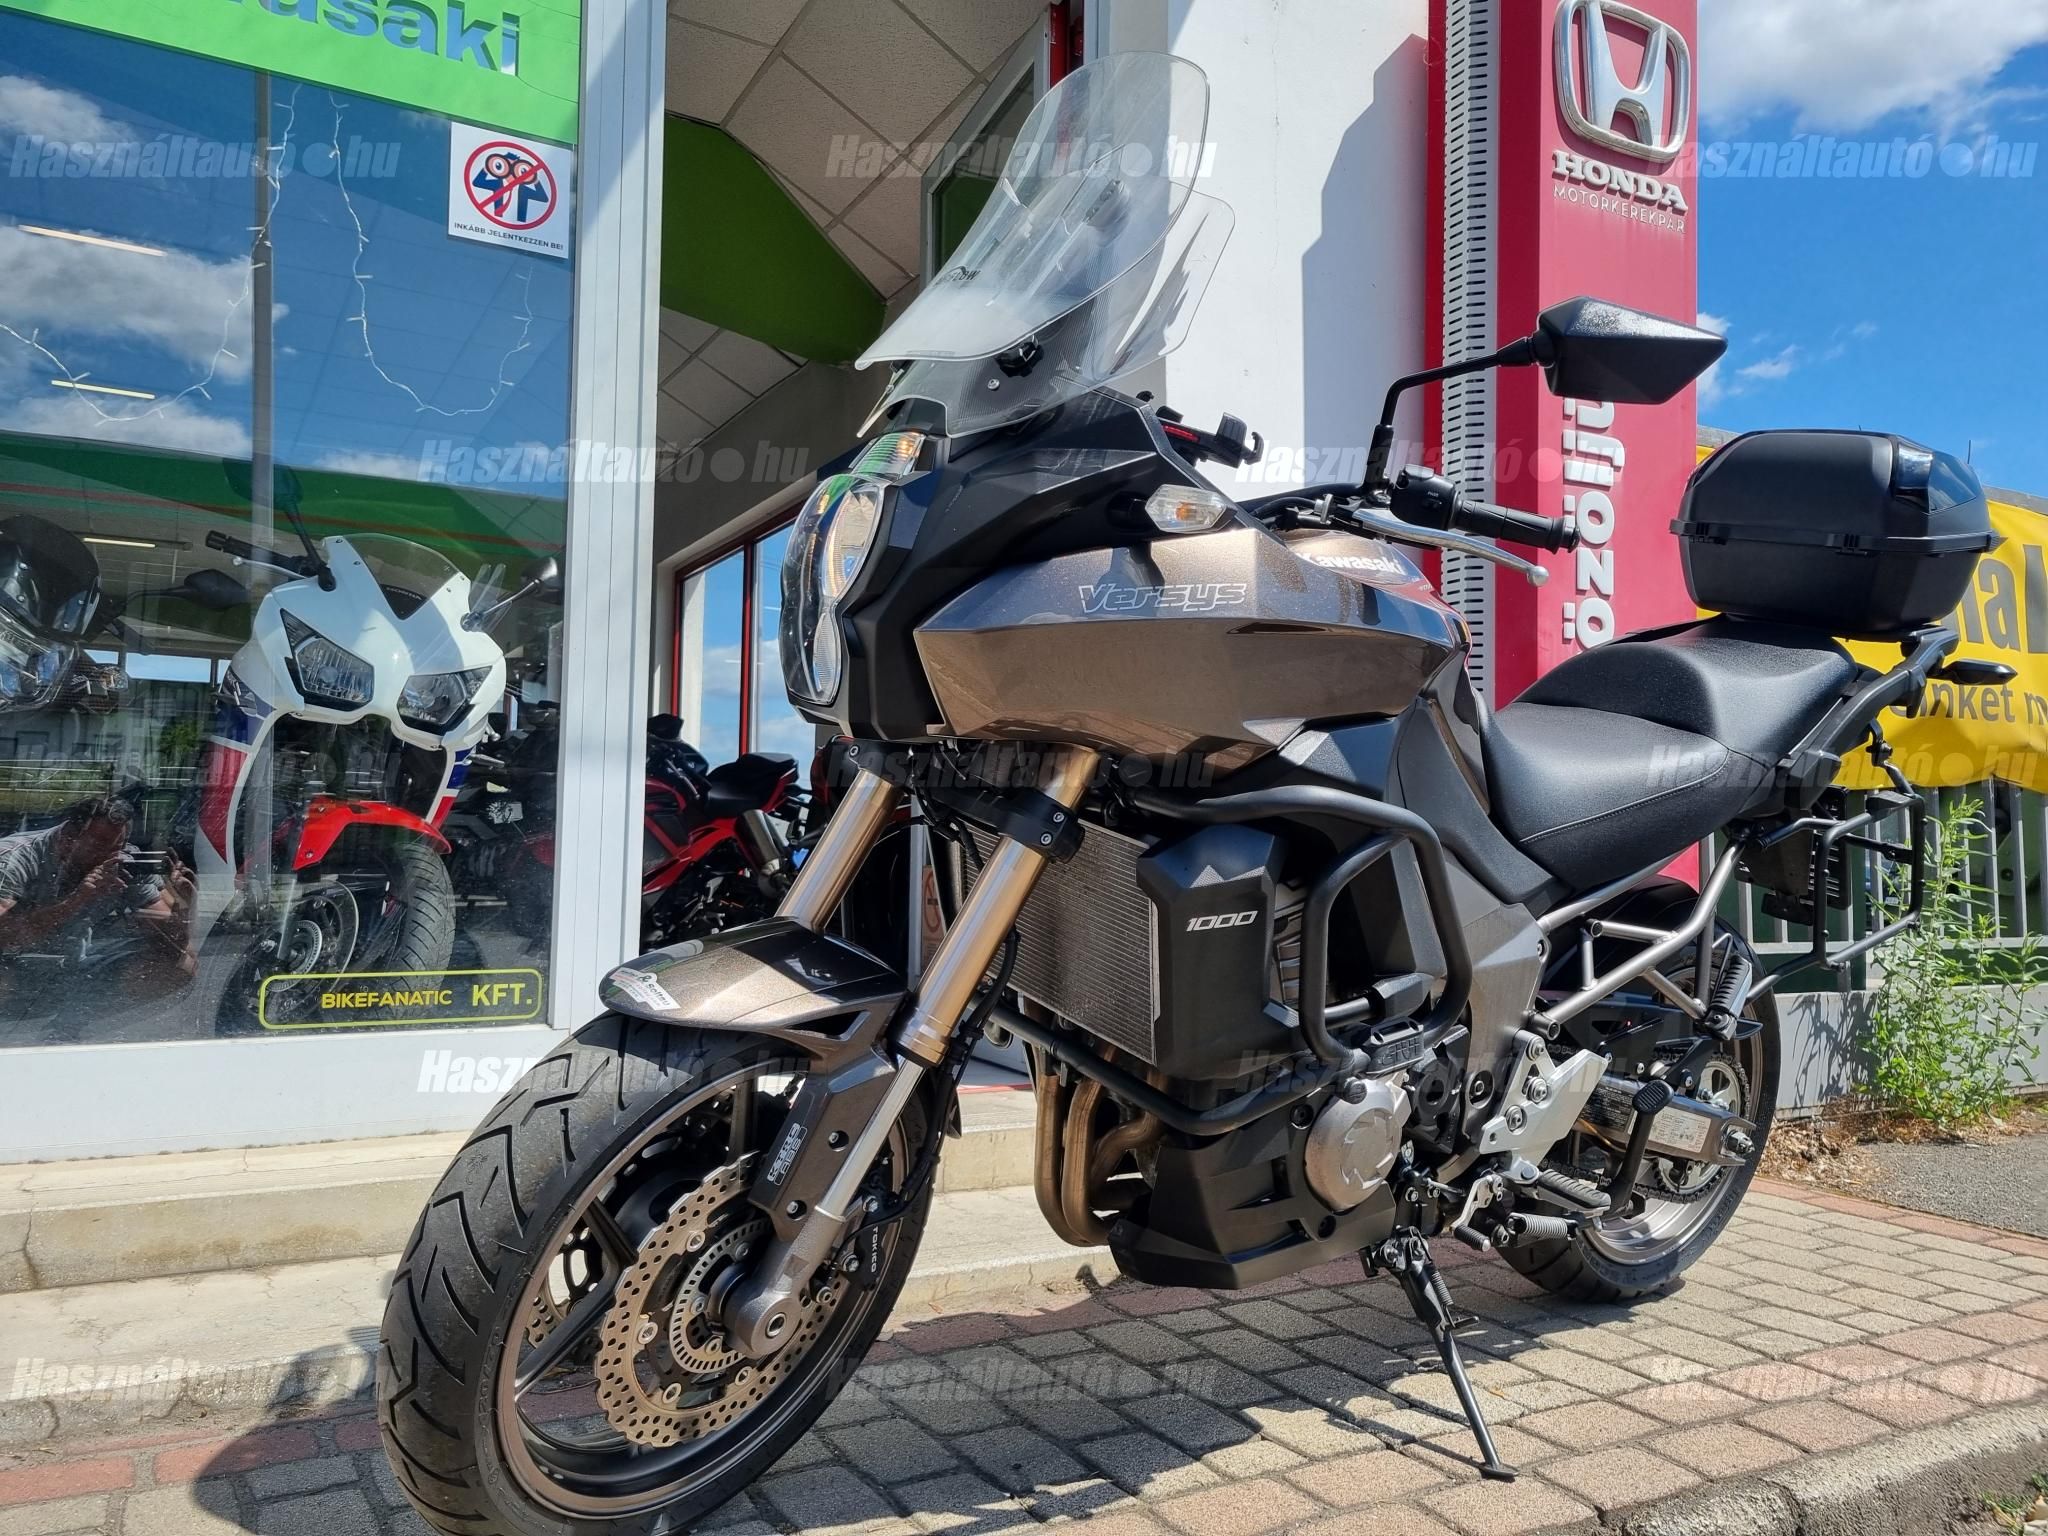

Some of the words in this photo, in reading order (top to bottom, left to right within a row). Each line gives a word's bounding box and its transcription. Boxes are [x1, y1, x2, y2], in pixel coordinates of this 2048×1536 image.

[1552, 149, 1689, 214] HONDA
[454, 222, 486, 234] INKÁBB
[487, 229, 549, 247] JELENTKEZZEN
[550, 242, 564, 250] BE!
[1078, 583, 1247, 612] Versys
[1186, 910, 1258, 932] 1000
[321, 990, 453, 1009] BIKEFANATIC
[472, 983, 533, 1006] KFT.
[779, 1138, 802, 1175] ABS
[871, 1225, 879, 1273] TOKICO
